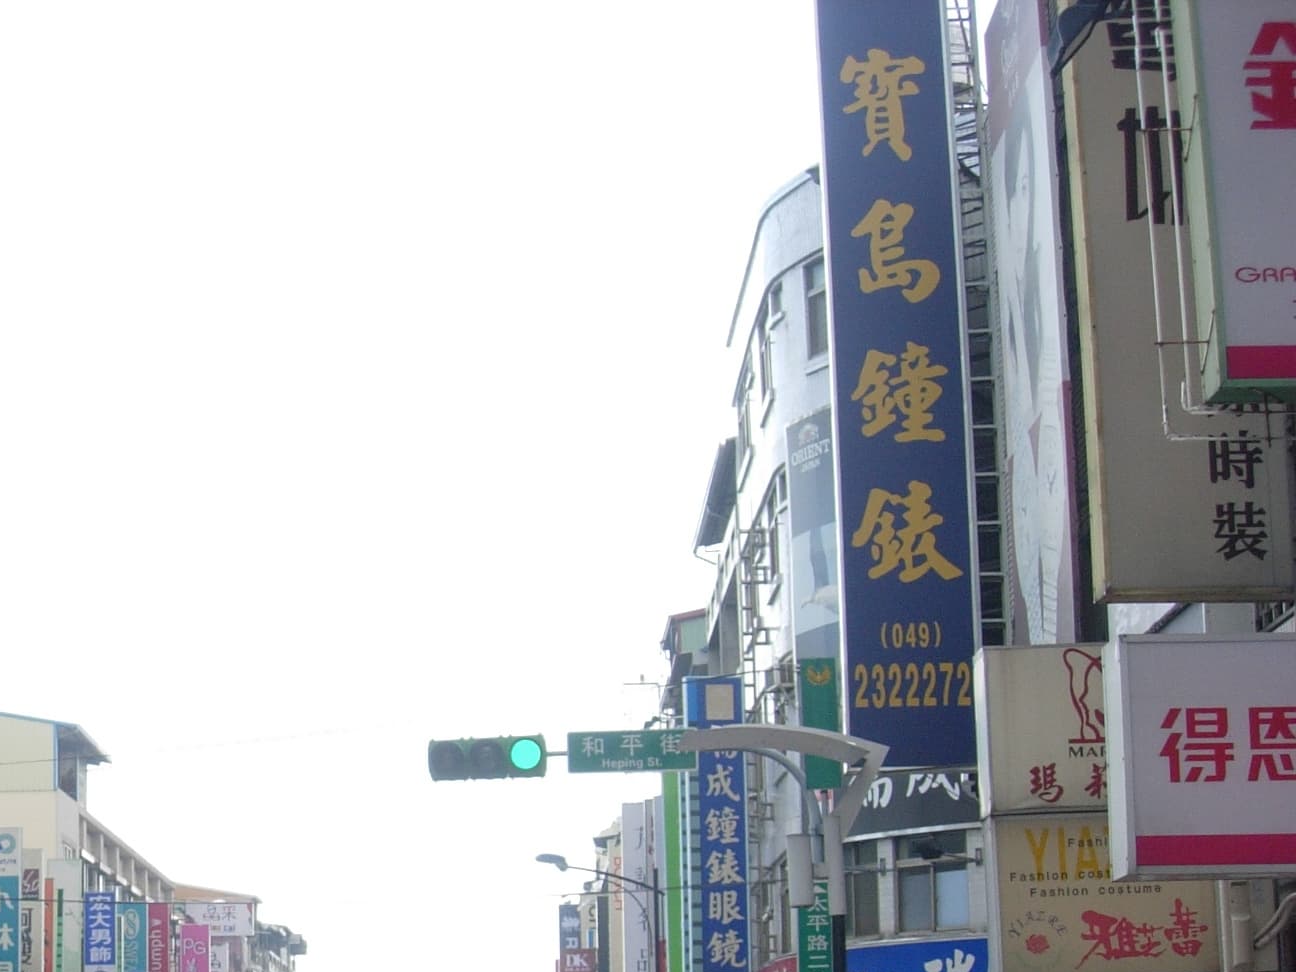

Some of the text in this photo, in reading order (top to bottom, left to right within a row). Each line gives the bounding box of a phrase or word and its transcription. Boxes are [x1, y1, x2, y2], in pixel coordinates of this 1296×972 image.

[839, 48, 964, 584] 寶島鐘錶
[791, 438, 831, 467] ORIENT
[1208, 430, 1269, 561] 時裝
[880, 622, 942, 649] (049)
[855, 662, 971, 709] 2322272
[582, 733, 690, 757] 和平街
[1159, 706, 1296, 783] 得恩
[602, 756, 663, 769] Heping St.
[705, 748, 747, 969] 成鐘錶眼鏡
[1024, 822, 1110, 883] YIA
[1009, 870, 1069, 882] Fashion
[1029, 887, 1090, 898] Fashion
[183, 938, 206, 957] PG
[566, 954, 587, 967] DK
